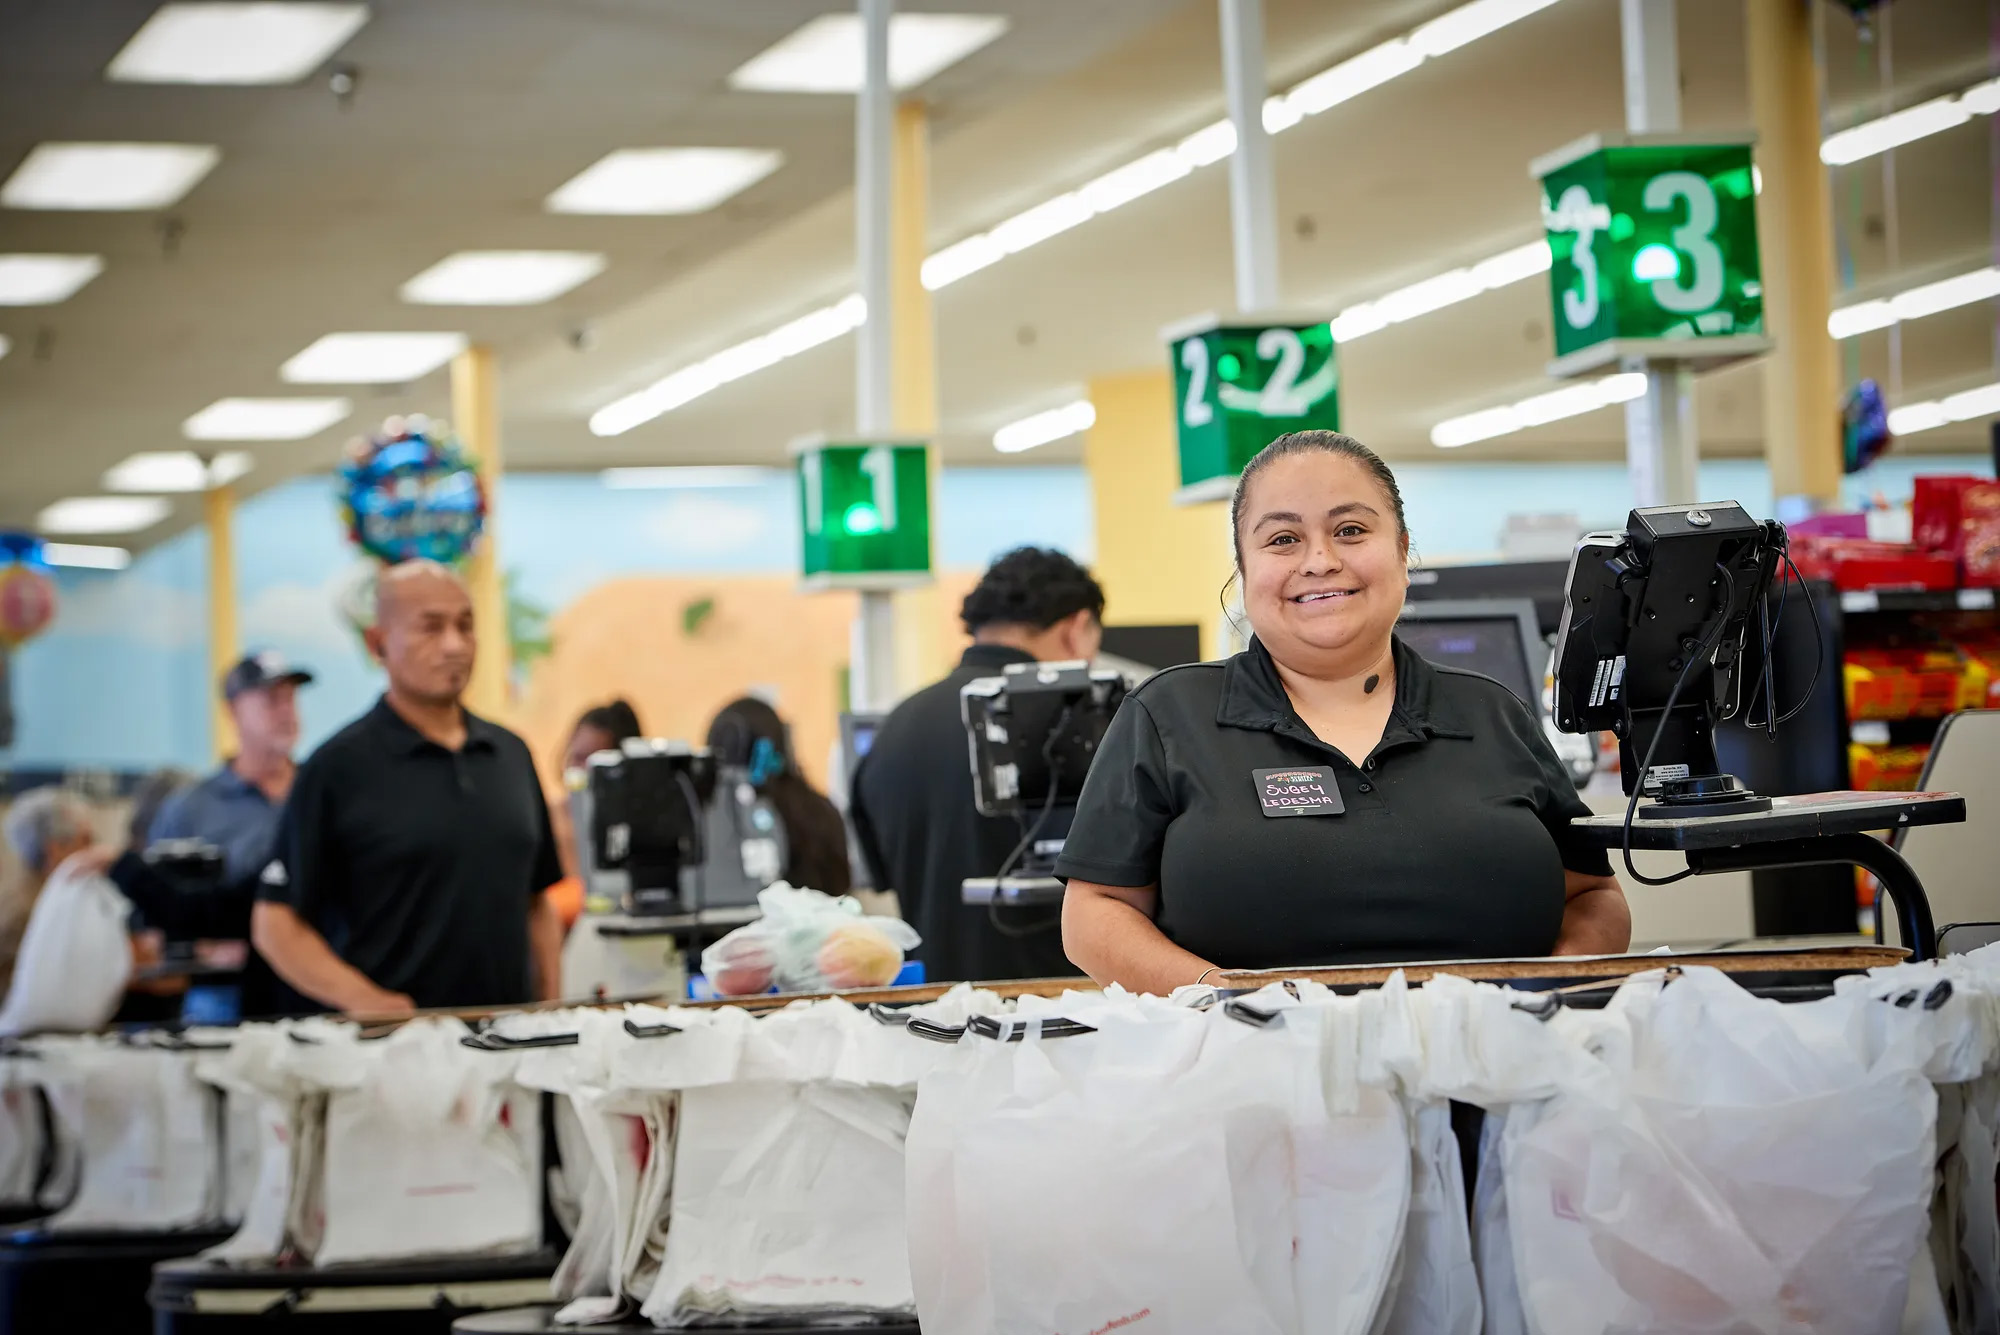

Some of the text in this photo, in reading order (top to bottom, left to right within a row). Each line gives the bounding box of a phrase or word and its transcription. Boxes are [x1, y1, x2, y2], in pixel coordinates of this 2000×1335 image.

[1642, 171, 1724, 314] 3
[1182, 337, 1212, 428] 2
[1256, 329, 1309, 416] 2
[860, 444, 896, 533] 1
[1262, 796, 1333, 808] LEDESMA
